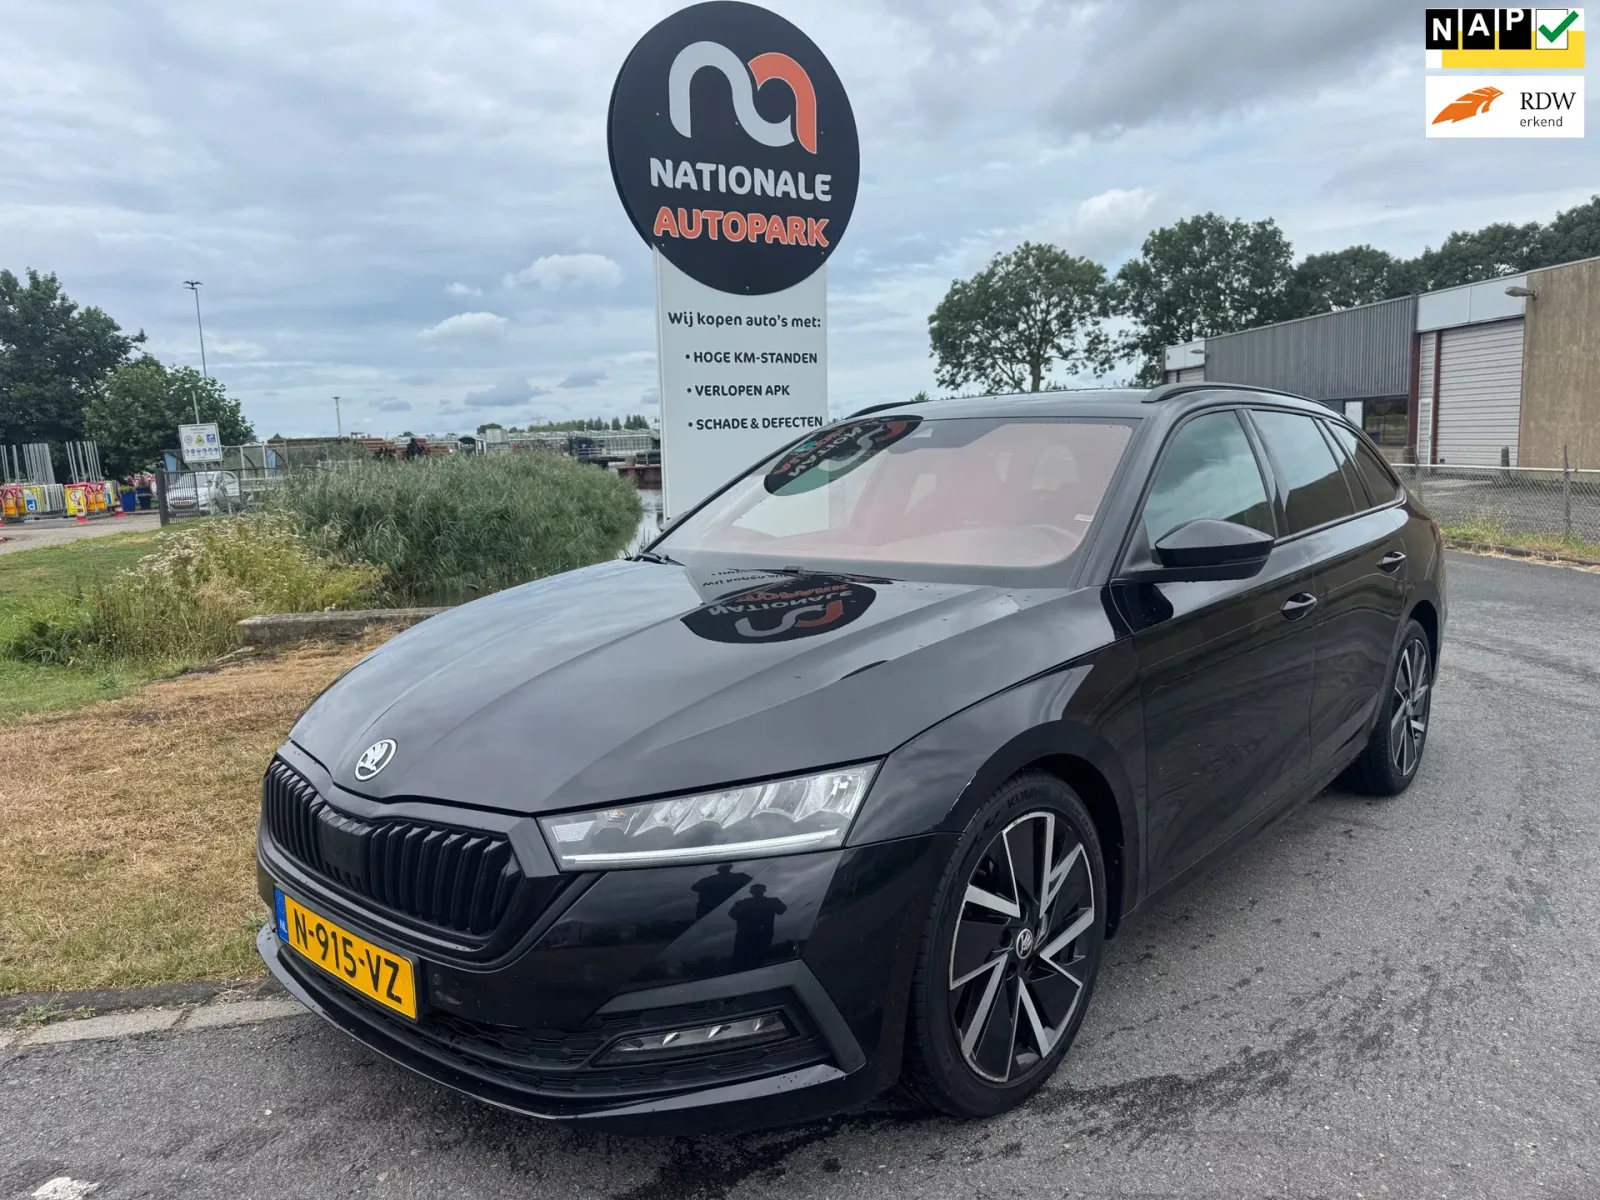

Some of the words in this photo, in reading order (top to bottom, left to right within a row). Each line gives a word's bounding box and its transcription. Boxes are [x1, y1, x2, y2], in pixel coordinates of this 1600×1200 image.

[649, 158, 832, 202] NATIONALE
[653, 206, 830, 248] AUTOPARK
[668, 312, 694, 328] Wij
[697, 312, 742, 327] kopen
[745, 315, 788, 328] auto's
[791, 317, 821, 328] met:
[693, 351, 731, 363] HOGE
[734, 352, 818, 364] KM-STANDEN
[695, 385, 763, 397] VERLOPEN
[765, 384, 791, 396] APK
[696, 418, 749, 430] SCHADE
[750, 418, 760, 430] &
[762, 416, 823, 429] DEFECTEN
[279, 918, 288, 933] NL
[293, 907, 402, 1005] N-915-VZ
